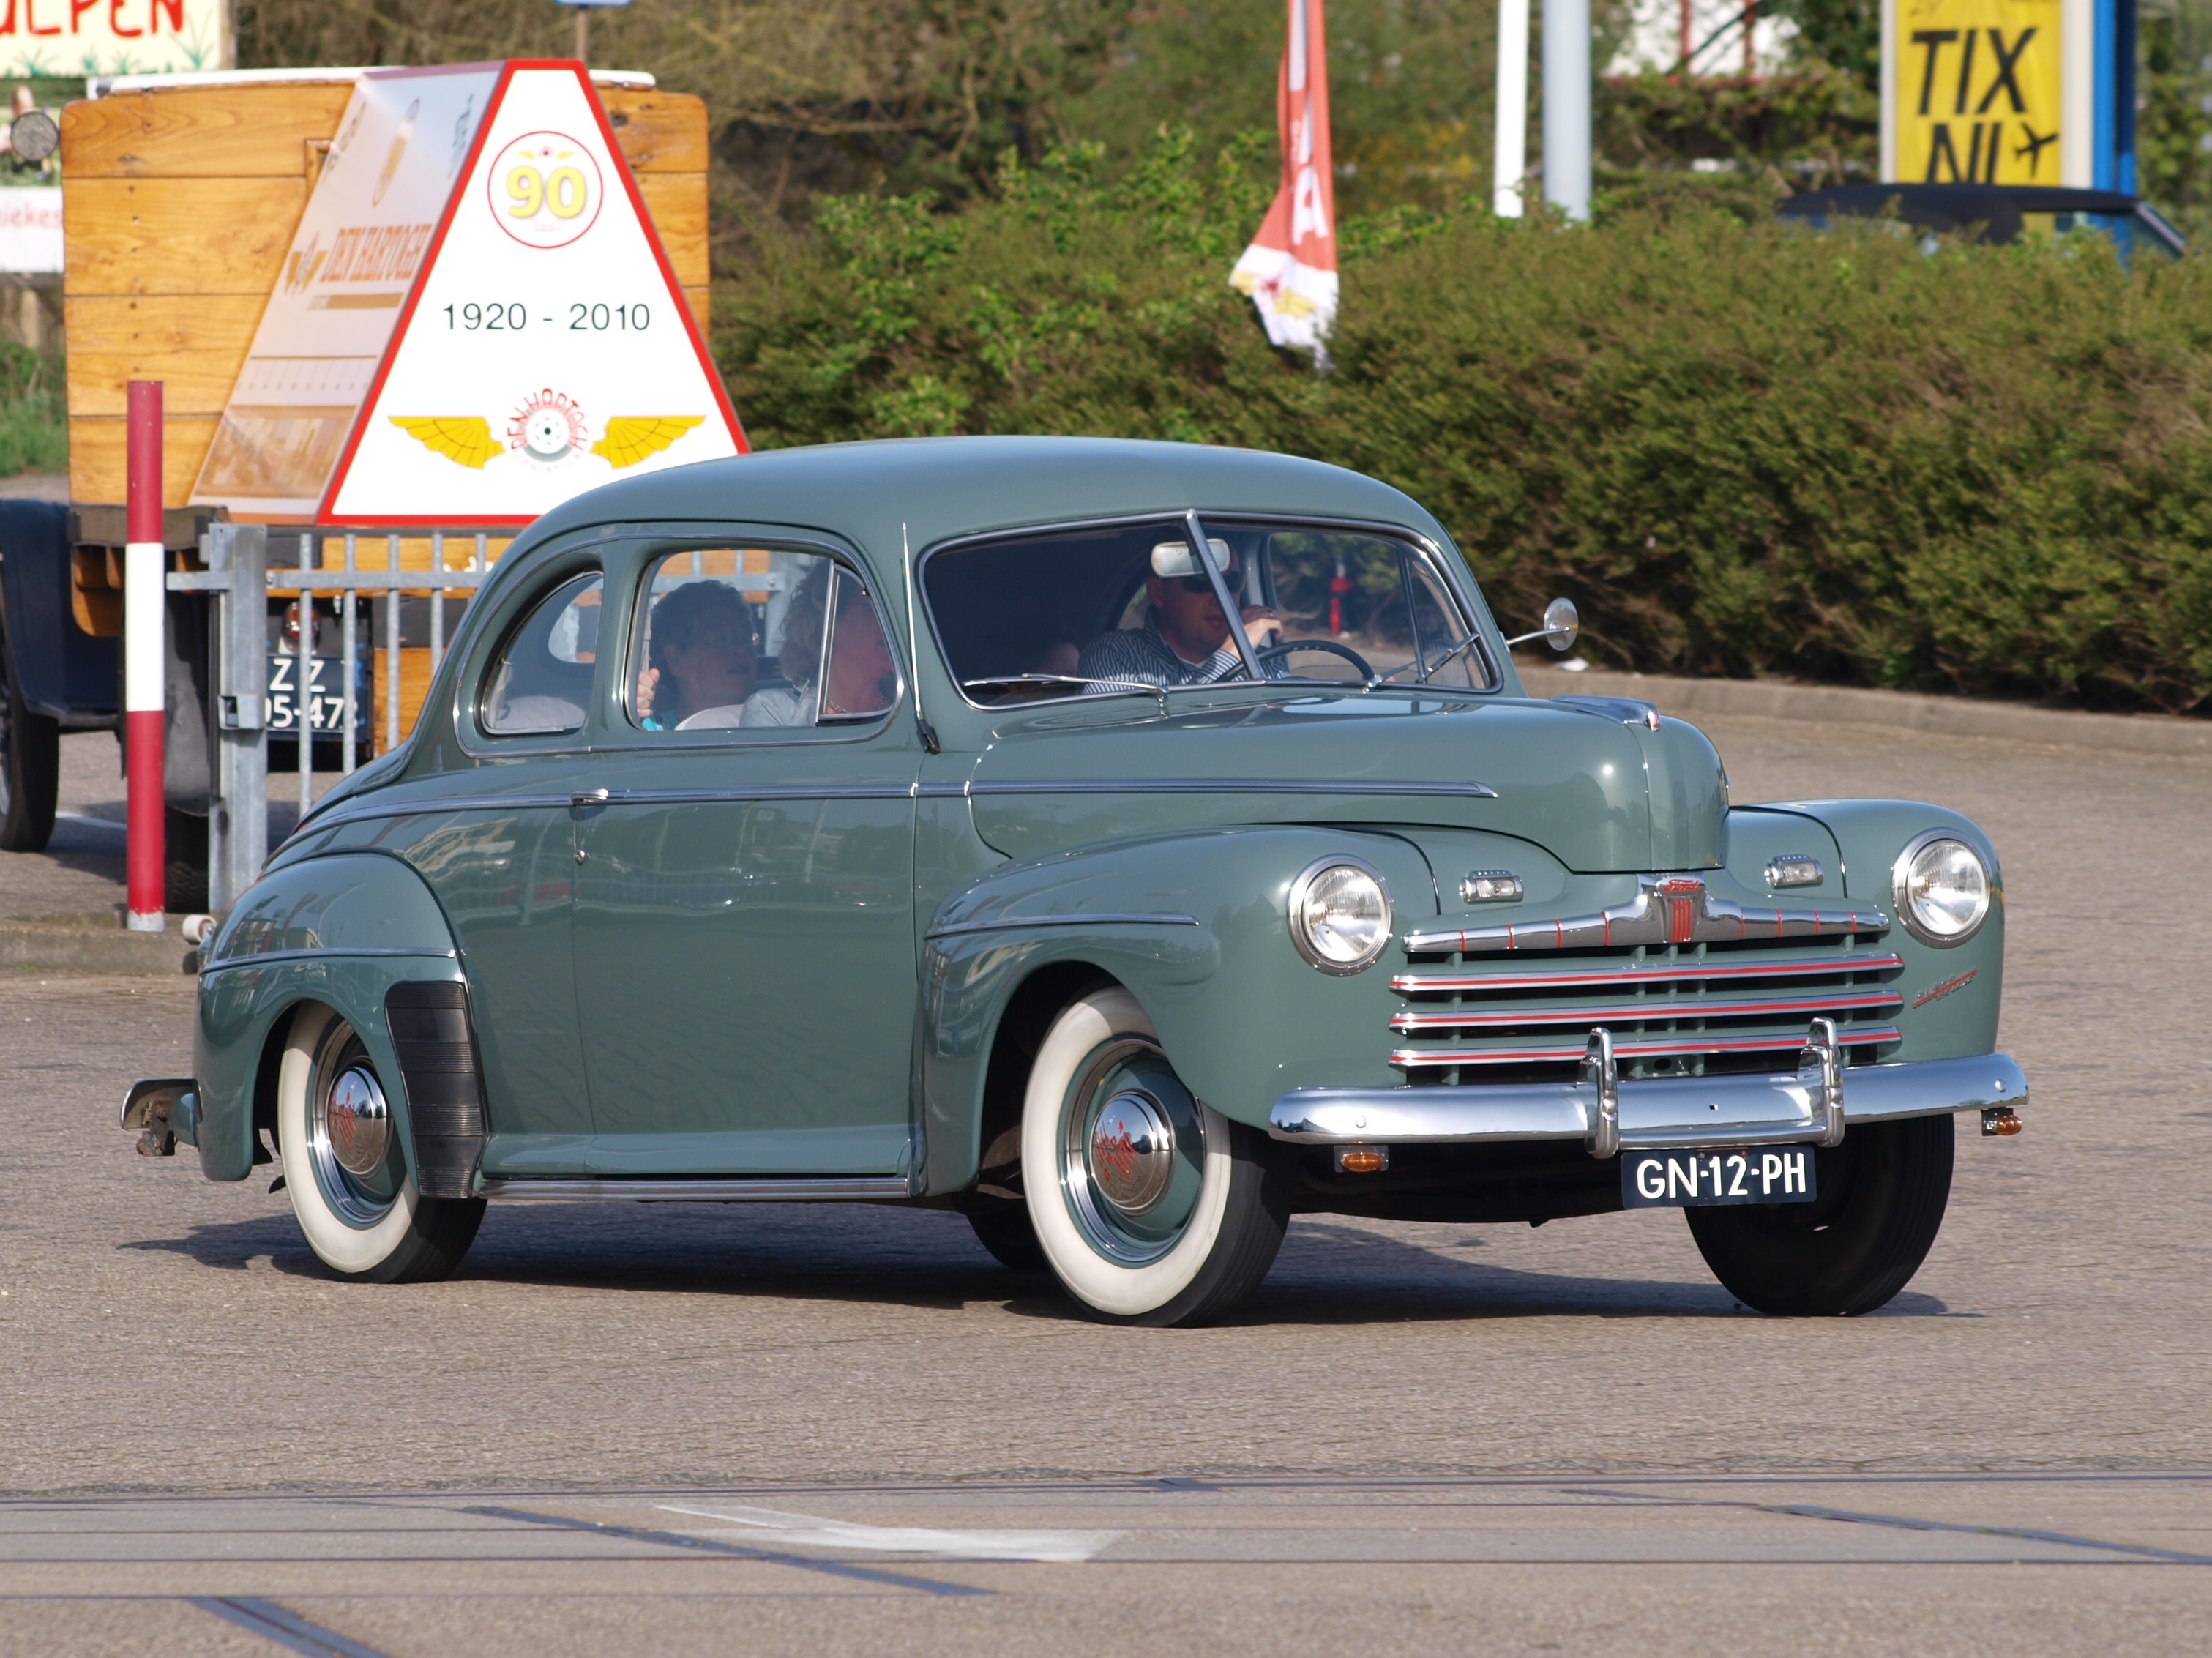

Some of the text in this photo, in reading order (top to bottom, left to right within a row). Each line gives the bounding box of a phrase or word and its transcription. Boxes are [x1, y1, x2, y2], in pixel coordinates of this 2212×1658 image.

[1911, 27, 2039, 116] TIX
[506, 165, 587, 219] 90
[443, 303, 527, 330] 1920
[569, 303, 650, 330] 2010
[1664, 879, 1700, 892] Ford
[1637, 1152, 1806, 1199] GN-12-PH
